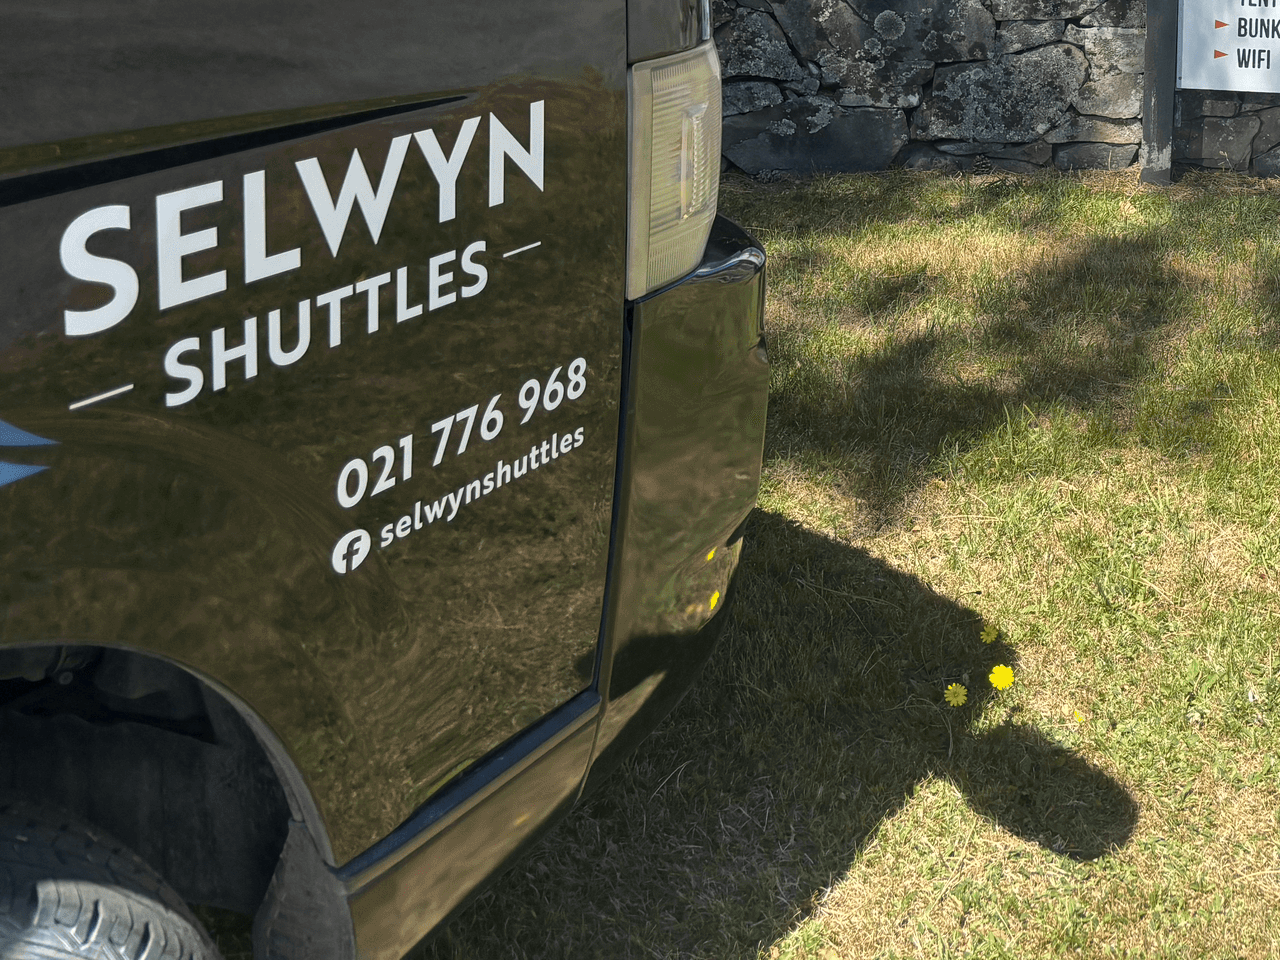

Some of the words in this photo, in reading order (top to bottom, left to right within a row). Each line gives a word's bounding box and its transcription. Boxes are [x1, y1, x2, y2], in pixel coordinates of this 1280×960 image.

[1236, 48, 1271, 70] WIFI
[59, 99, 546, 337] SELWYN
[163, 240, 489, 407] SHUTTLES
[336, 433, 414, 509] 021
[431, 393, 504, 467] 776
[518, 357, 587, 426] 968
[380, 426, 585, 548] selwynshuttles
